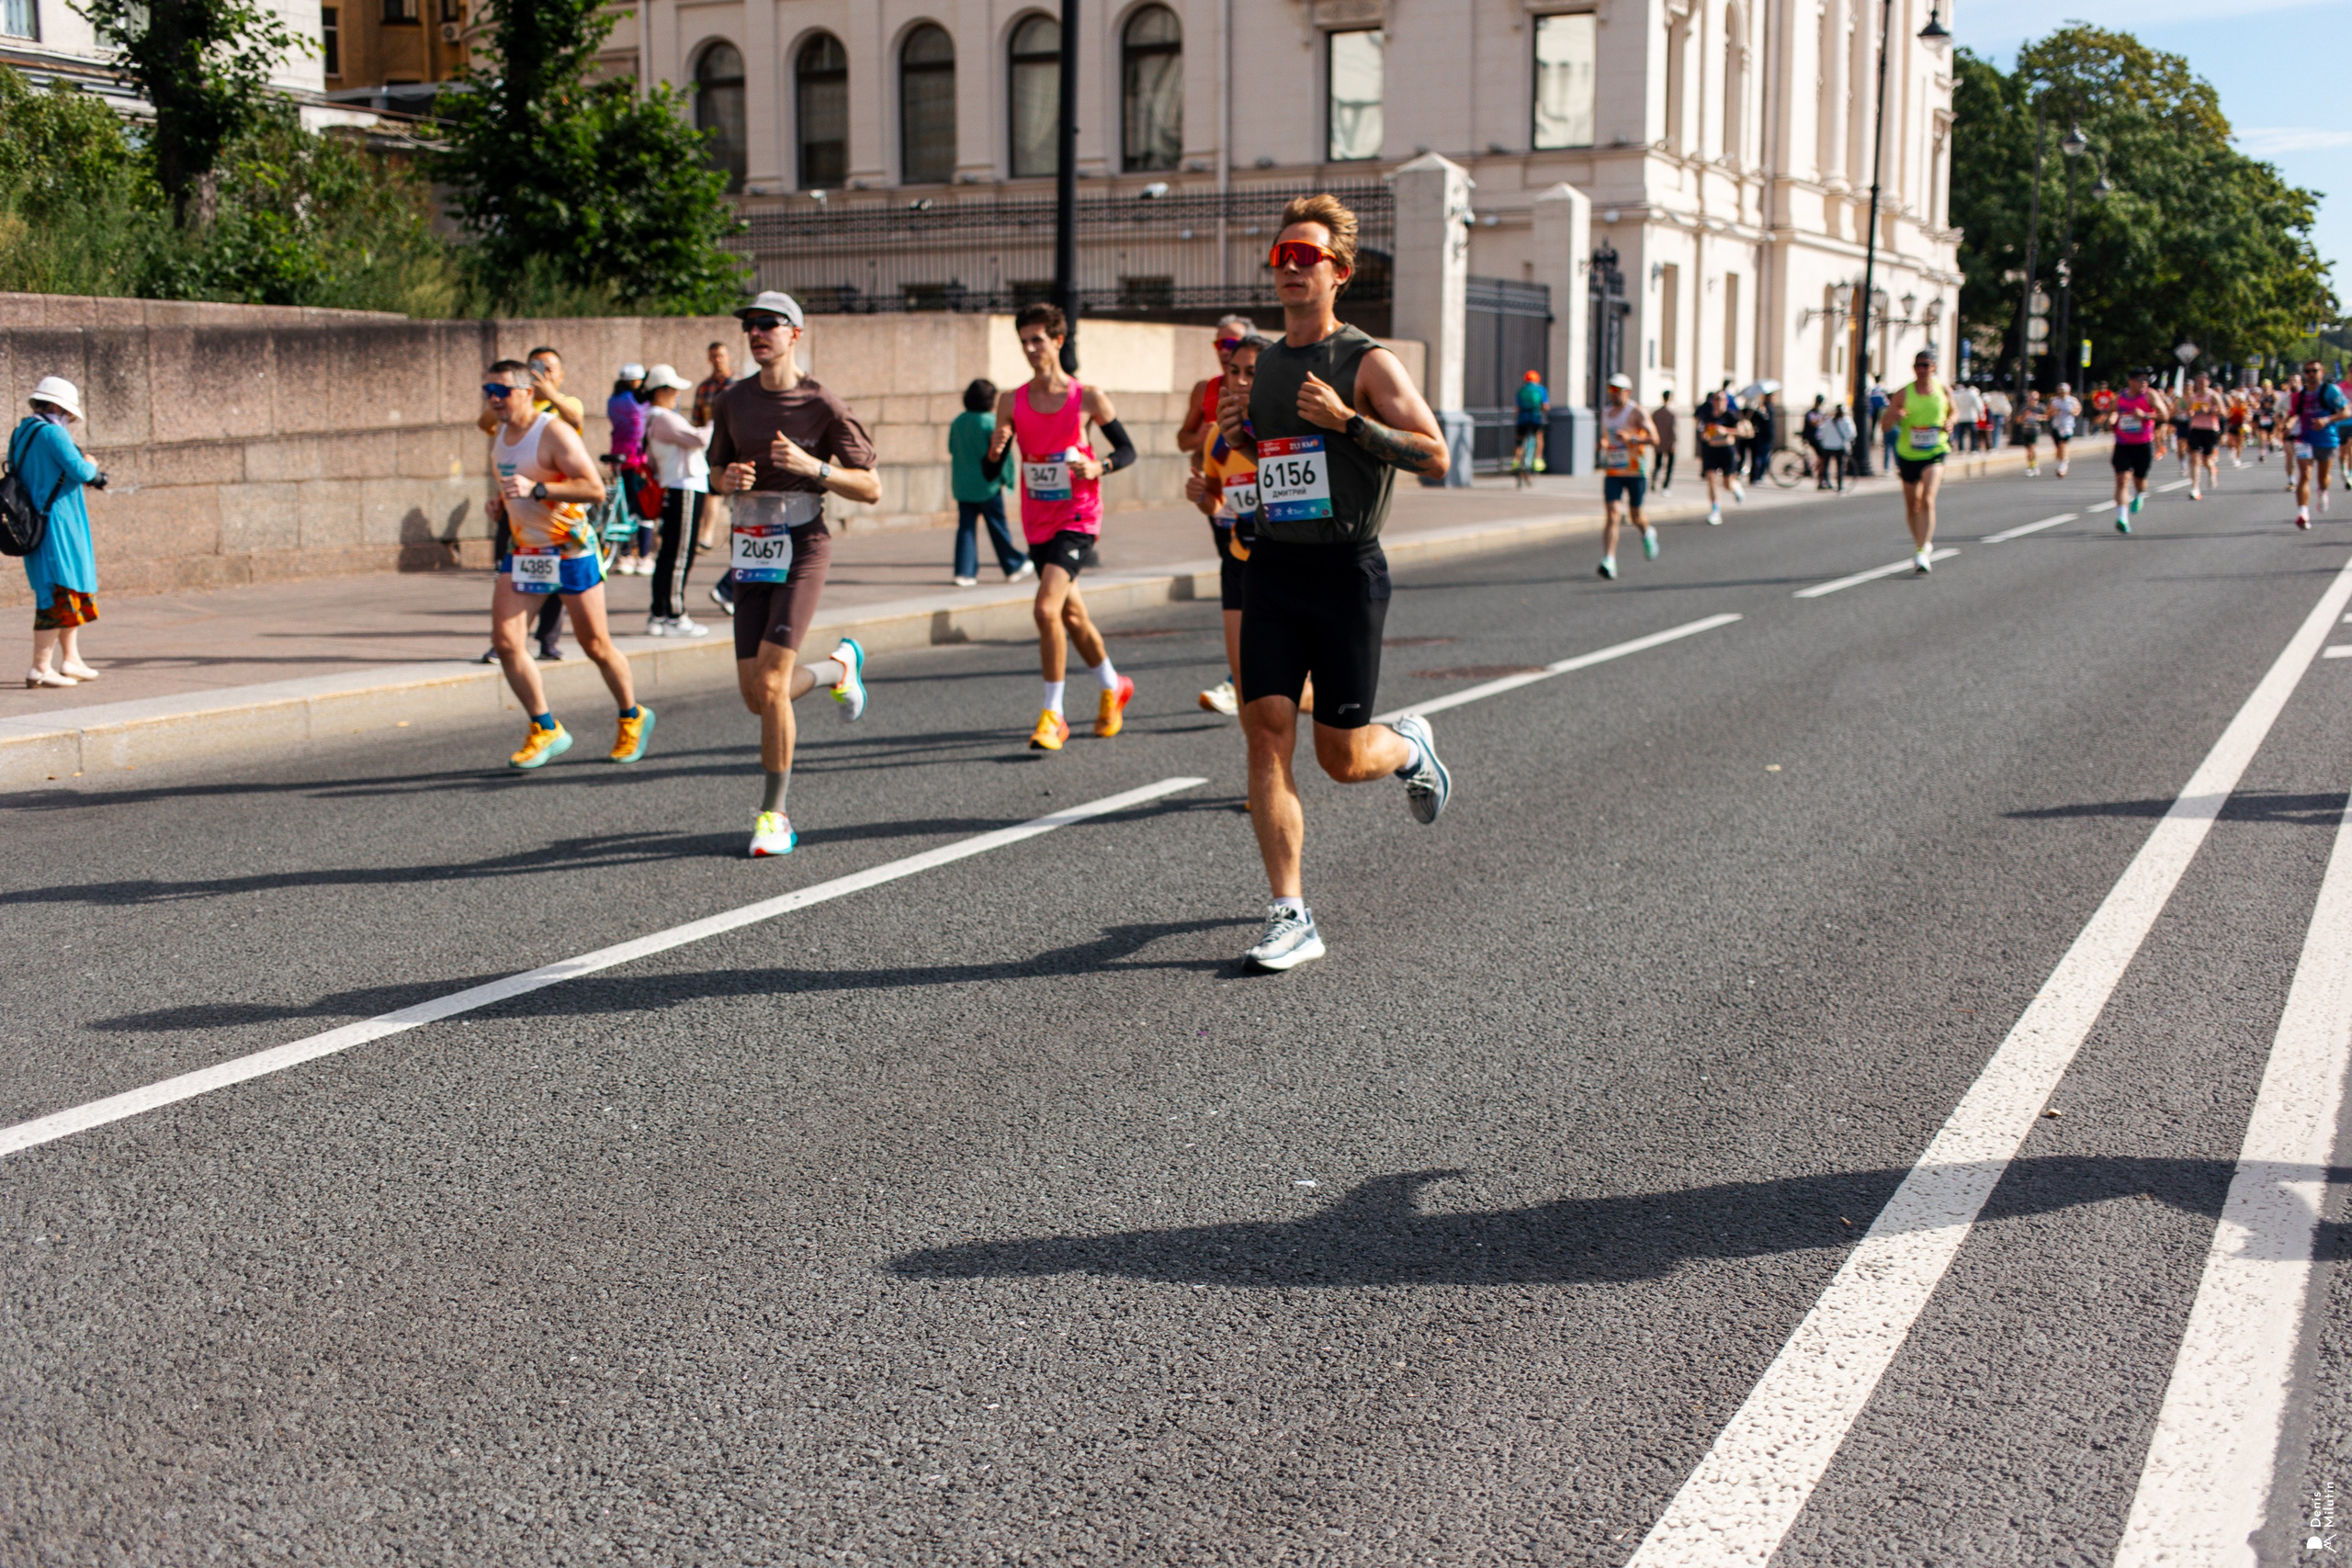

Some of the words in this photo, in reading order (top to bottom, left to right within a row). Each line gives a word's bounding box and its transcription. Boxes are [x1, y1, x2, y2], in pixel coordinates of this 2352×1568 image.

[1031, 467, 1057, 481] 347
[1263, 460, 1316, 489] 6156
[1272, 487, 1307, 499] ДМИТРИЙ
[741, 539, 784, 558] 2067
[520, 558, 553, 574] 4385
